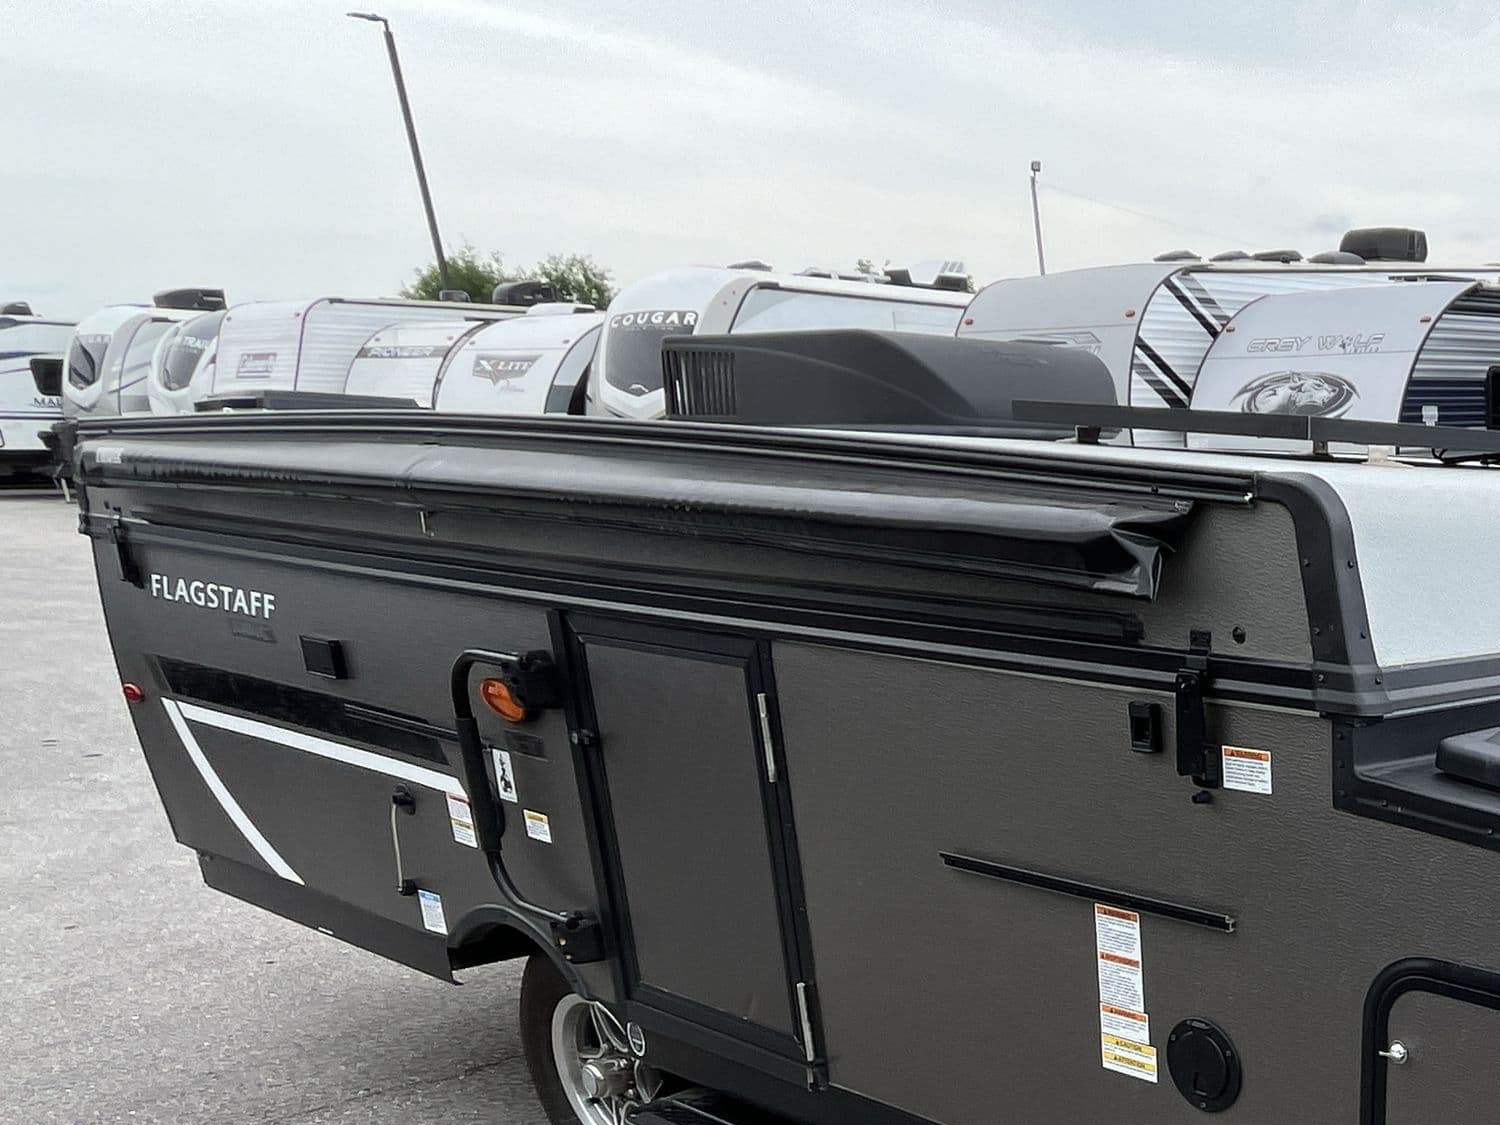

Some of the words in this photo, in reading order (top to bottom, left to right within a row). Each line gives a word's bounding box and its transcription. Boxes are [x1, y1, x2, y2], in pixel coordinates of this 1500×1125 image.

[611, 311, 697, 328] COUGAR
[1247, 336, 1312, 352] GREY
[150, 573, 277, 619] FLAGSTAFF
